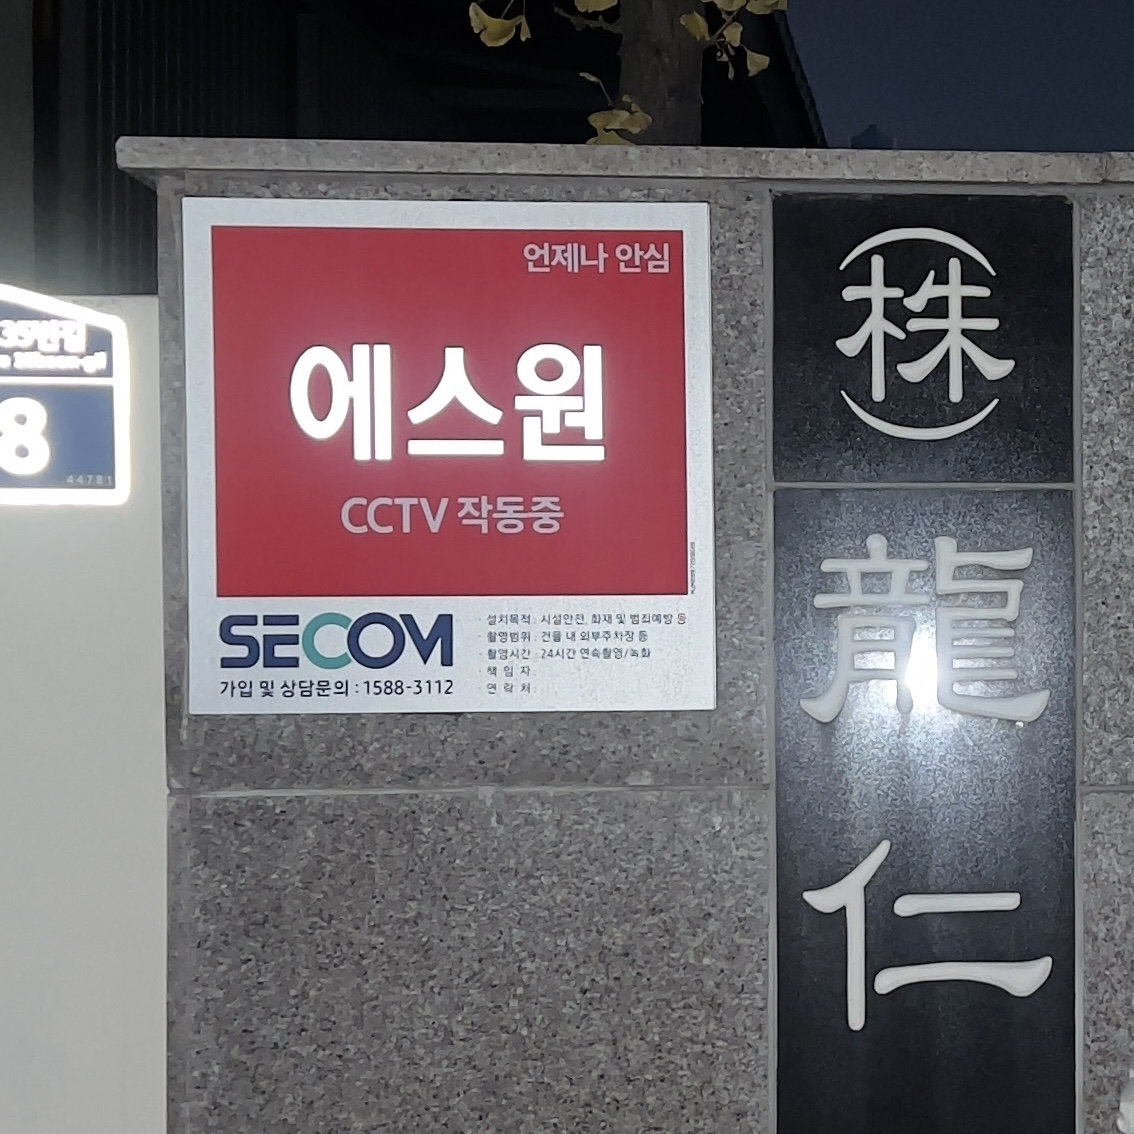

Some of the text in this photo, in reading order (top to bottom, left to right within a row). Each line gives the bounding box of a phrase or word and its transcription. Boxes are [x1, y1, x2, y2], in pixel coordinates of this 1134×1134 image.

[523, 242, 670, 274] 언제나 안심
[290, 342, 606, 461] 에스원
[340, 496, 565, 534] CCTV 작동중
[487, 613, 531, 626] 설치목적
[591, 613, 613, 625] 화재
[616, 613, 626, 624] 및
[219, 612, 454, 670] SECOM
[541, 648, 576, 660] 24시간
[220, 680, 253, 698] 가입
[259, 680, 275, 698] 및
[280, 680, 349, 698] 상담문의
[363, 679, 454, 696] 1588-3112
